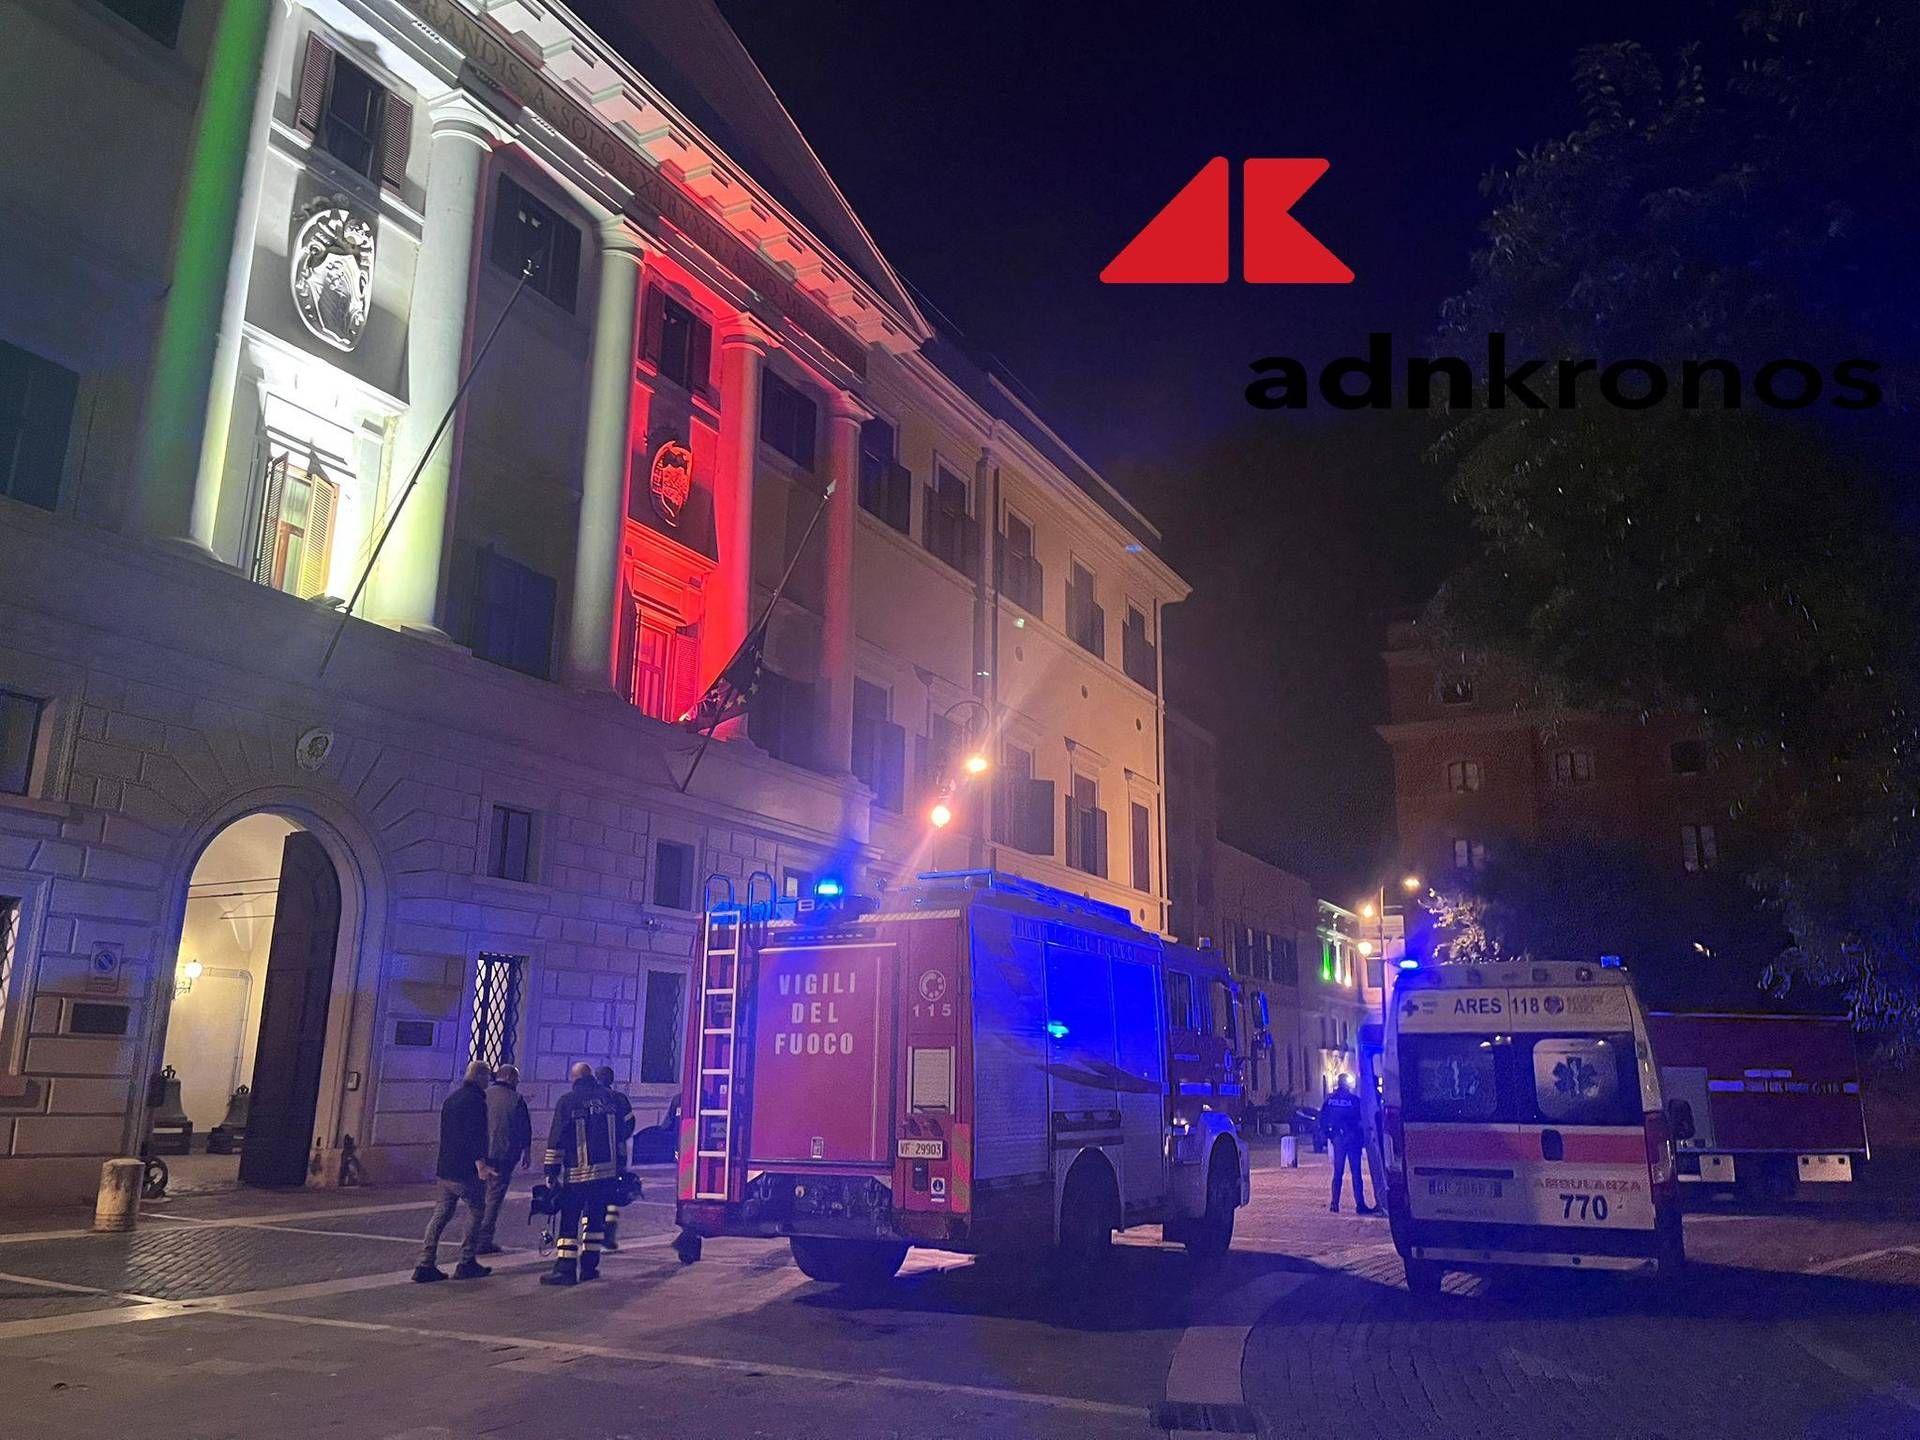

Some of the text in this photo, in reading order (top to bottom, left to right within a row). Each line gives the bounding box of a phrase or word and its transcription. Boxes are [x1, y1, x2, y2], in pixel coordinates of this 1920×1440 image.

[778, 972, 856, 995] VIGILI
[791, 1002, 839, 1024] DEL
[912, 1003, 951, 1017] 115
[1454, 997, 1502, 1014] ARES
[1512, 997, 1540, 1014] 118
[775, 1032, 854, 1055] FUOCO
[915, 1142, 942, 1156] 29903
[1559, 1193, 1609, 1220] 770
